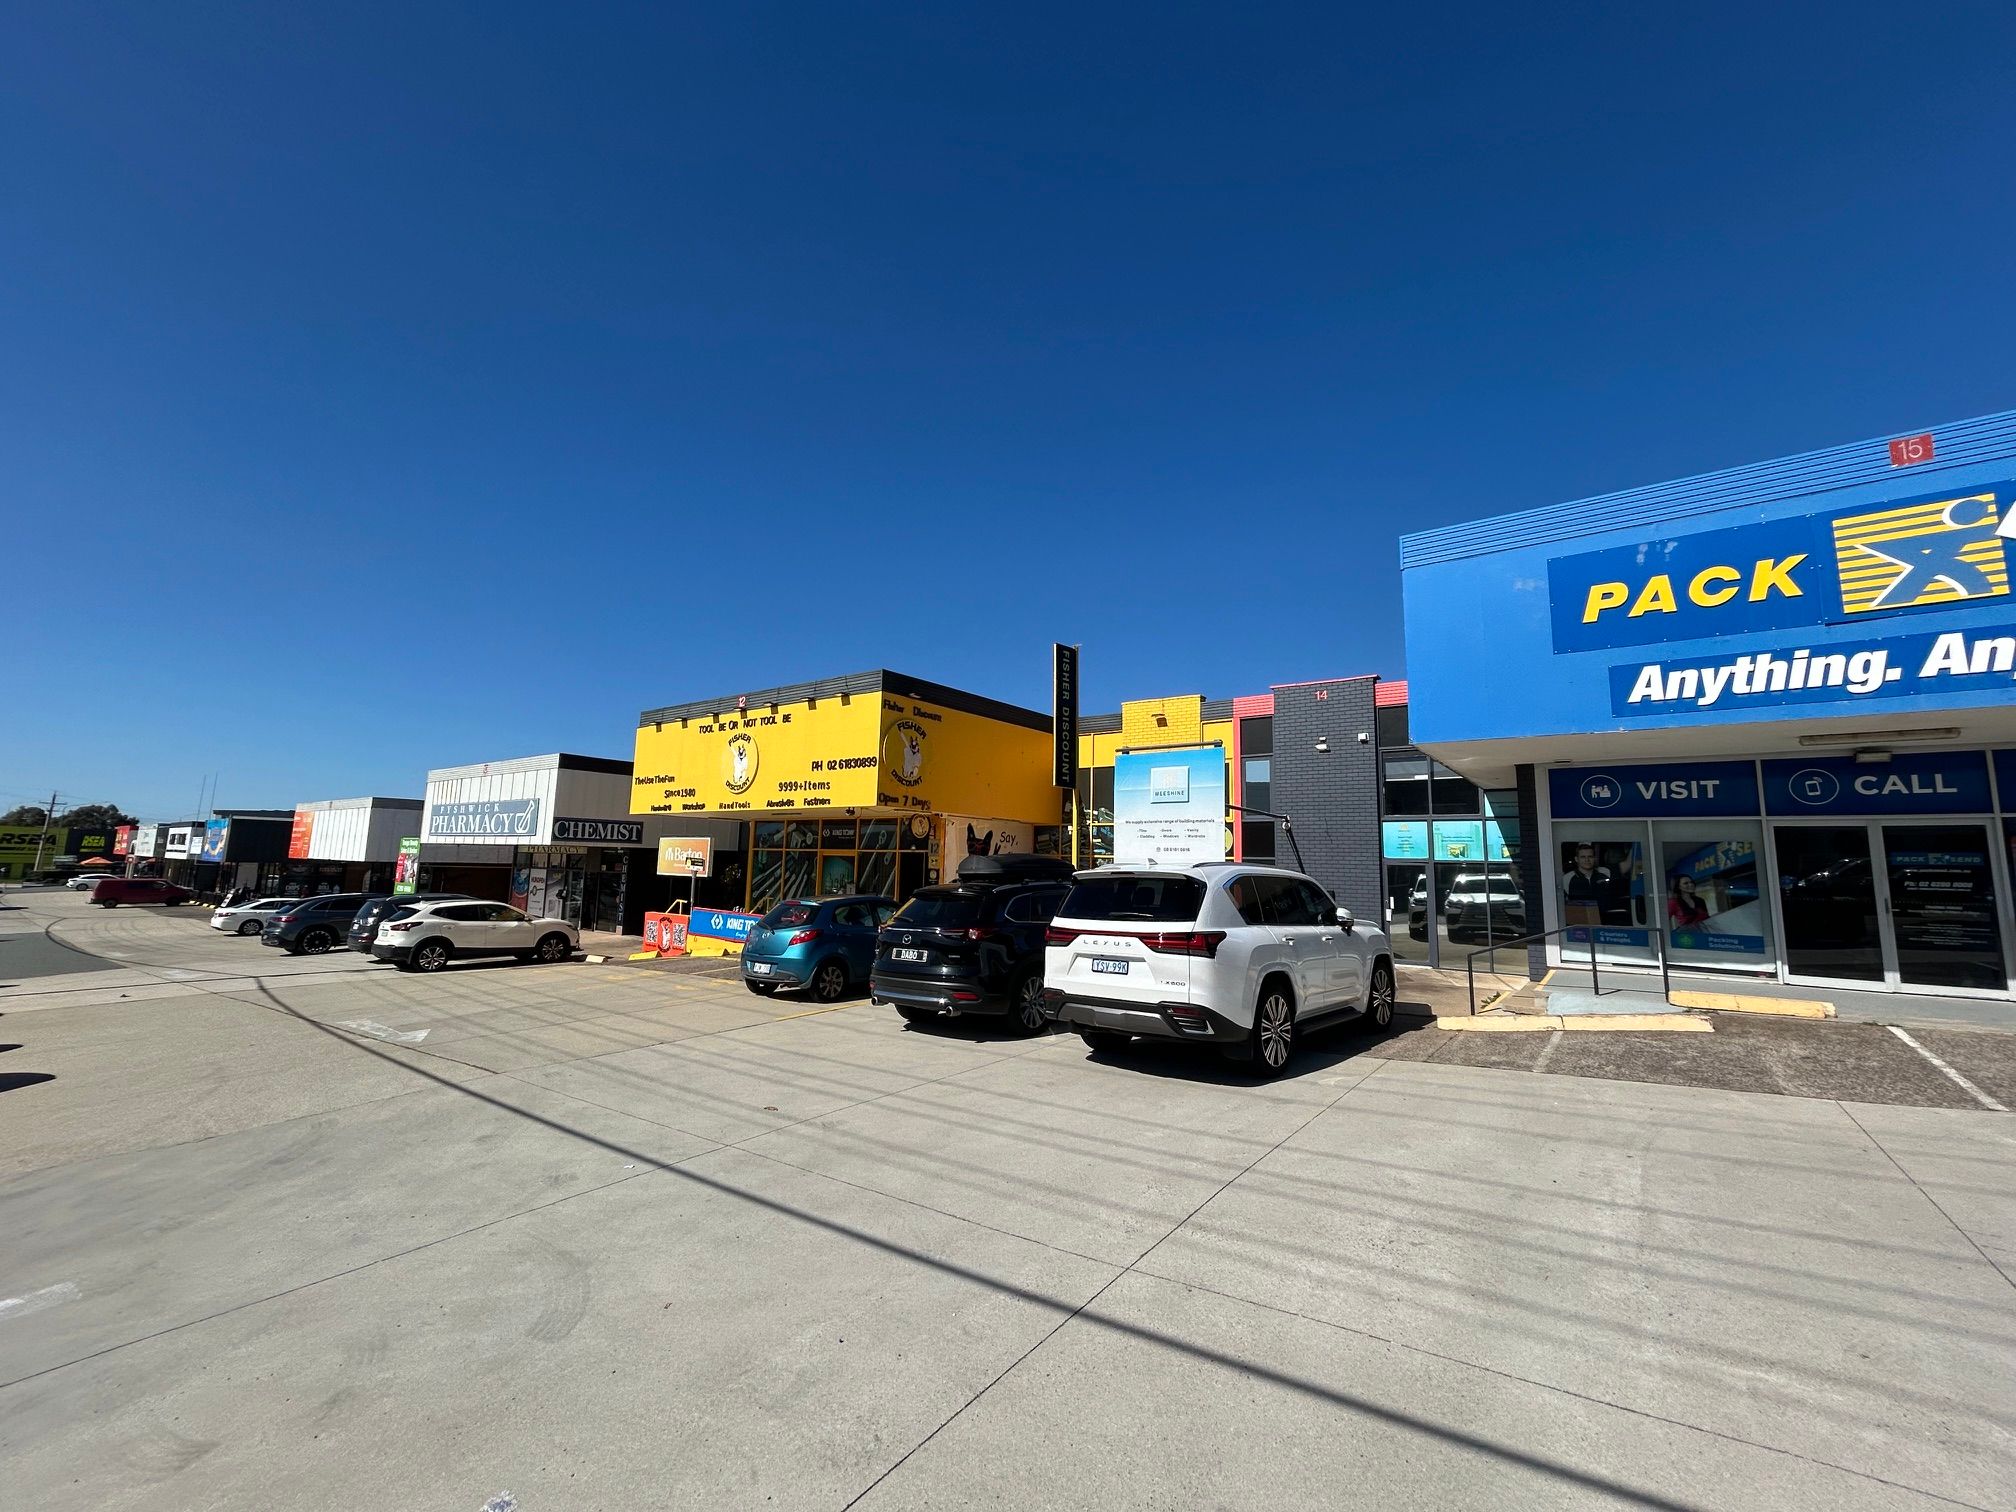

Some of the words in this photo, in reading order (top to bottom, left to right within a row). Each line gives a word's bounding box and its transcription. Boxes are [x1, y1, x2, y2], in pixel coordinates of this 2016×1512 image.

[1898, 438, 1923, 460] 15
[1582, 554, 1809, 624] PACK
[1062, 650, 1070, 700] FISHER
[1627, 649, 1901, 706] Anything.
[1918, 632, 2016, 680] An
[738, 696, 746, 707] 12
[1315, 690, 1328, 700] 14
[699, 724, 714, 734] TOOL
[718, 722, 727, 732] BE
[728, 720, 738, 731] OR
[743, 718, 757, 728] NOT
[760, 715, 777, 726] TOOL
[782, 713, 791, 724] BE
[897, 721, 927, 740] FISHER
[728, 733, 751, 747] FISHER
[1062, 706, 1070, 783] DISCOUNT
[812, 760, 823, 771] PH
[827, 760, 837, 770] 02
[725, 776, 750, 791] DISCOUNT
[891, 769, 922, 787] DISCOUNT
[1636, 780, 1719, 800] VISIT
[1854, 773, 1958, 795] CALL
[440, 803, 499, 814] FYSHWICK
[879, 793, 899, 806] Open
[903, 795, 909, 806] 7
[912, 797, 931, 810] Days
[431, 813, 513, 833] PHARMACY
[553, 820, 640, 840] CHEMIST
[930, 842, 939, 854] 12
[726, 917, 744, 930] KING
[1083, 939, 1132, 948] LEXUS
[1708, 936, 1739, 945] Packing
[1708, 942, 1745, 950] Solutions
